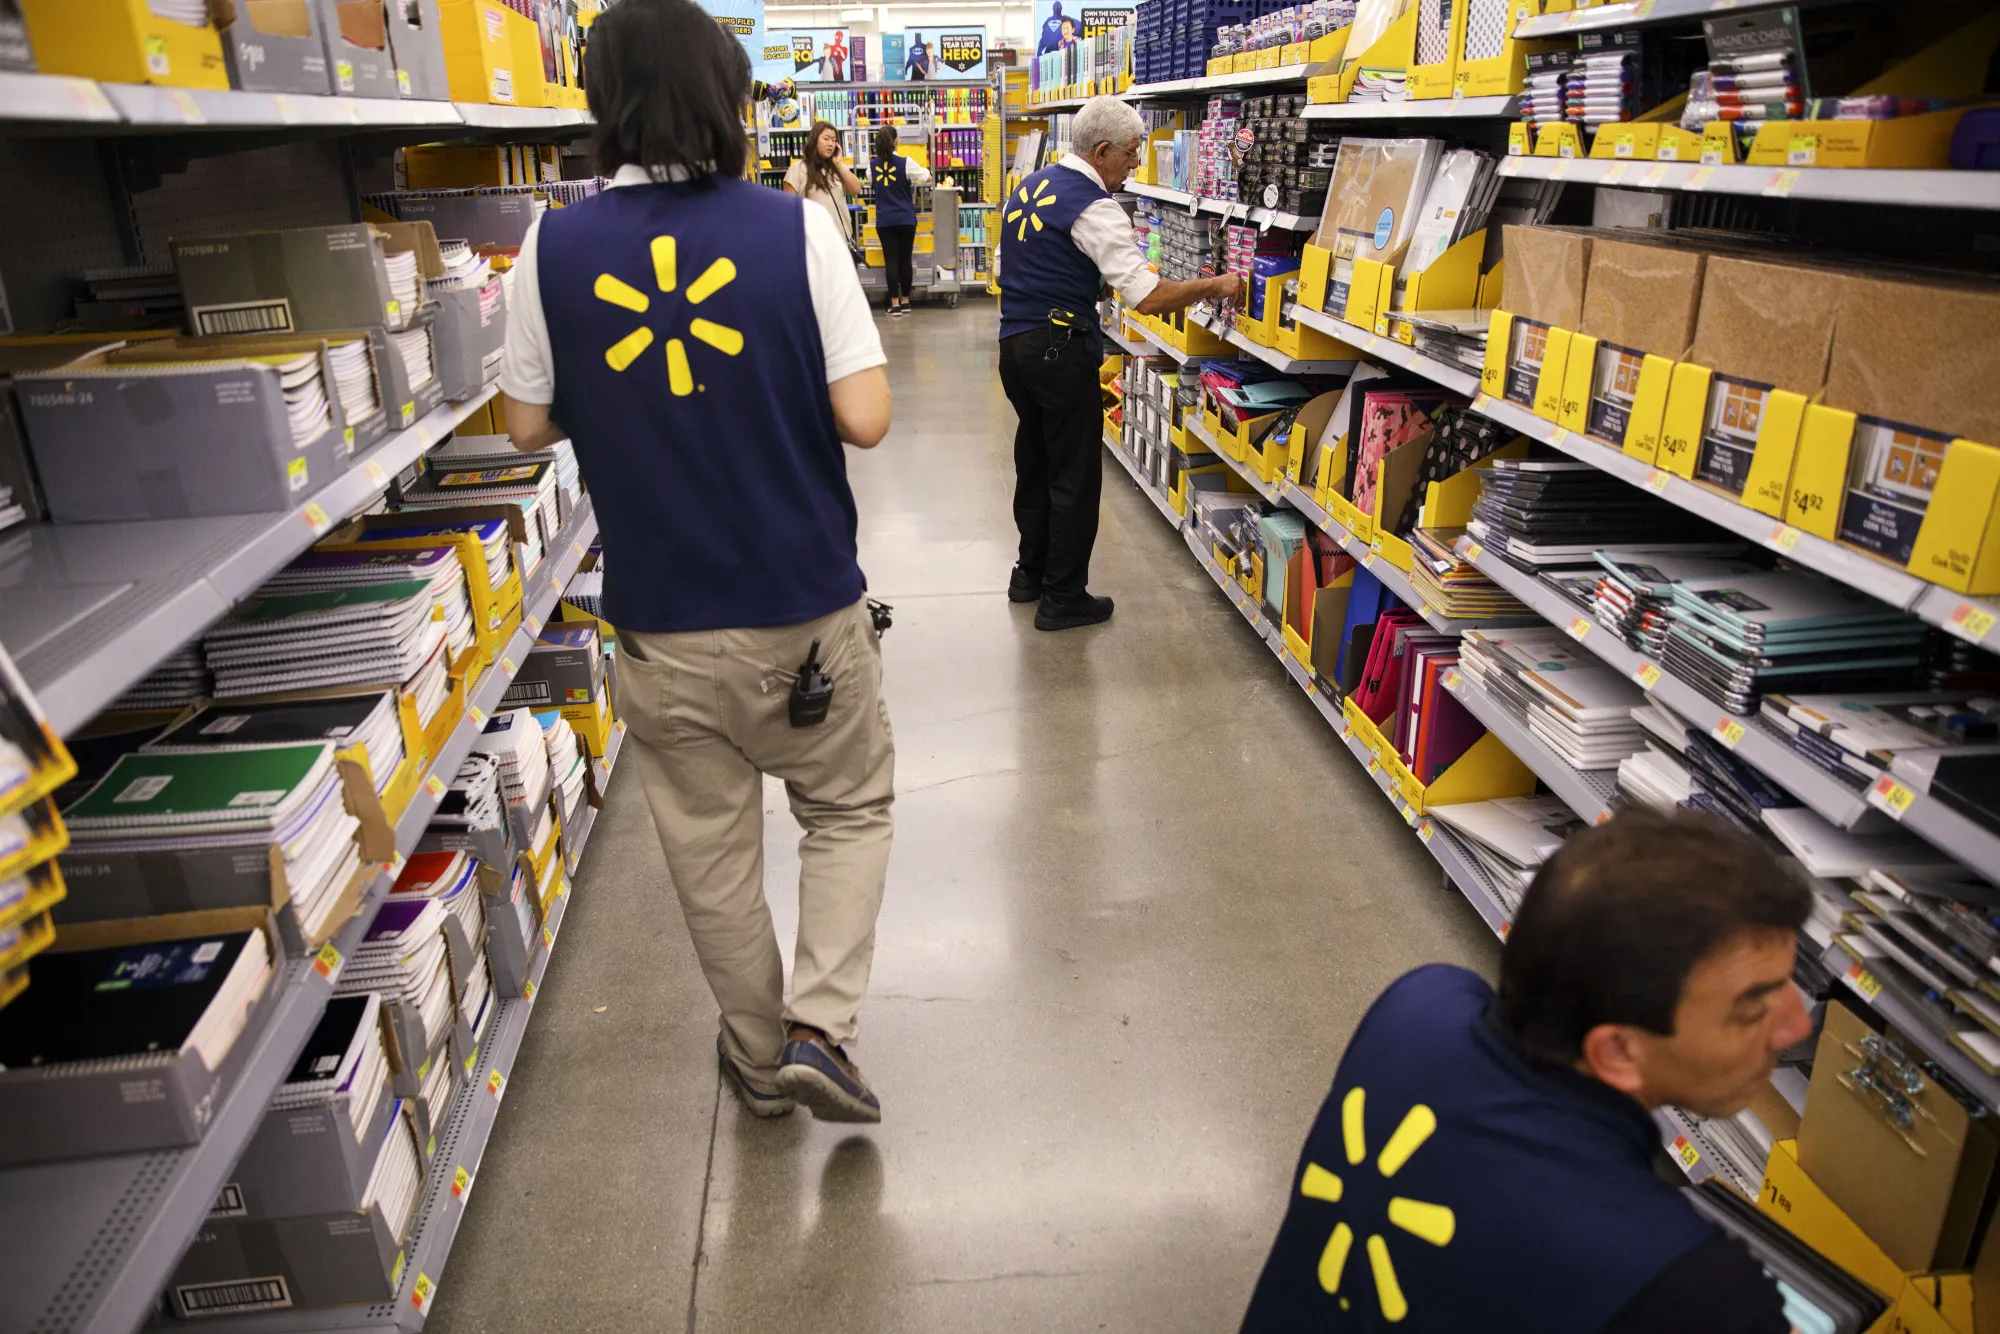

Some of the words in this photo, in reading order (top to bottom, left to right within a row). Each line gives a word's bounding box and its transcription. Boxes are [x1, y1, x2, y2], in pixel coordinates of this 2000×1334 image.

[737, 18, 755, 26] FILES
[1107, 17, 1124, 25] LIKE
[1084, 26, 1118, 38] HE
[805, 42, 812, 50] A
[943, 48, 981, 61] HERO
